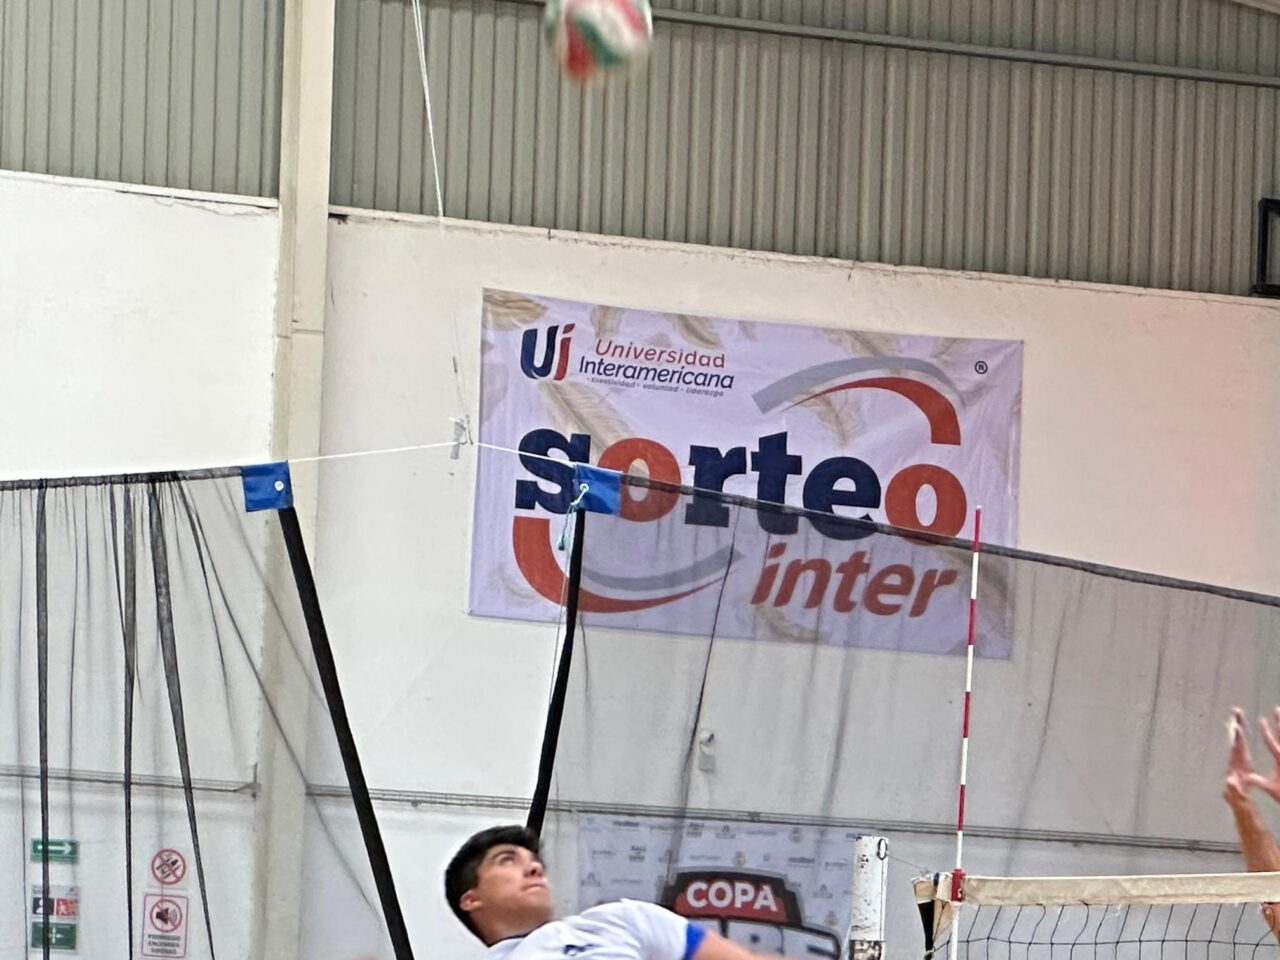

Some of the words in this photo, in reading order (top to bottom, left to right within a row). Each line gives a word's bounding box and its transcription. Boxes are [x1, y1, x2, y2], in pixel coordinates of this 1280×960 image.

[595, 339, 725, 369] Universidad
[579, 356, 735, 390] Interamericana
[514, 428, 968, 546] sorteo
[750, 541, 959, 618] inter
[686, 881, 778, 912] COPA
